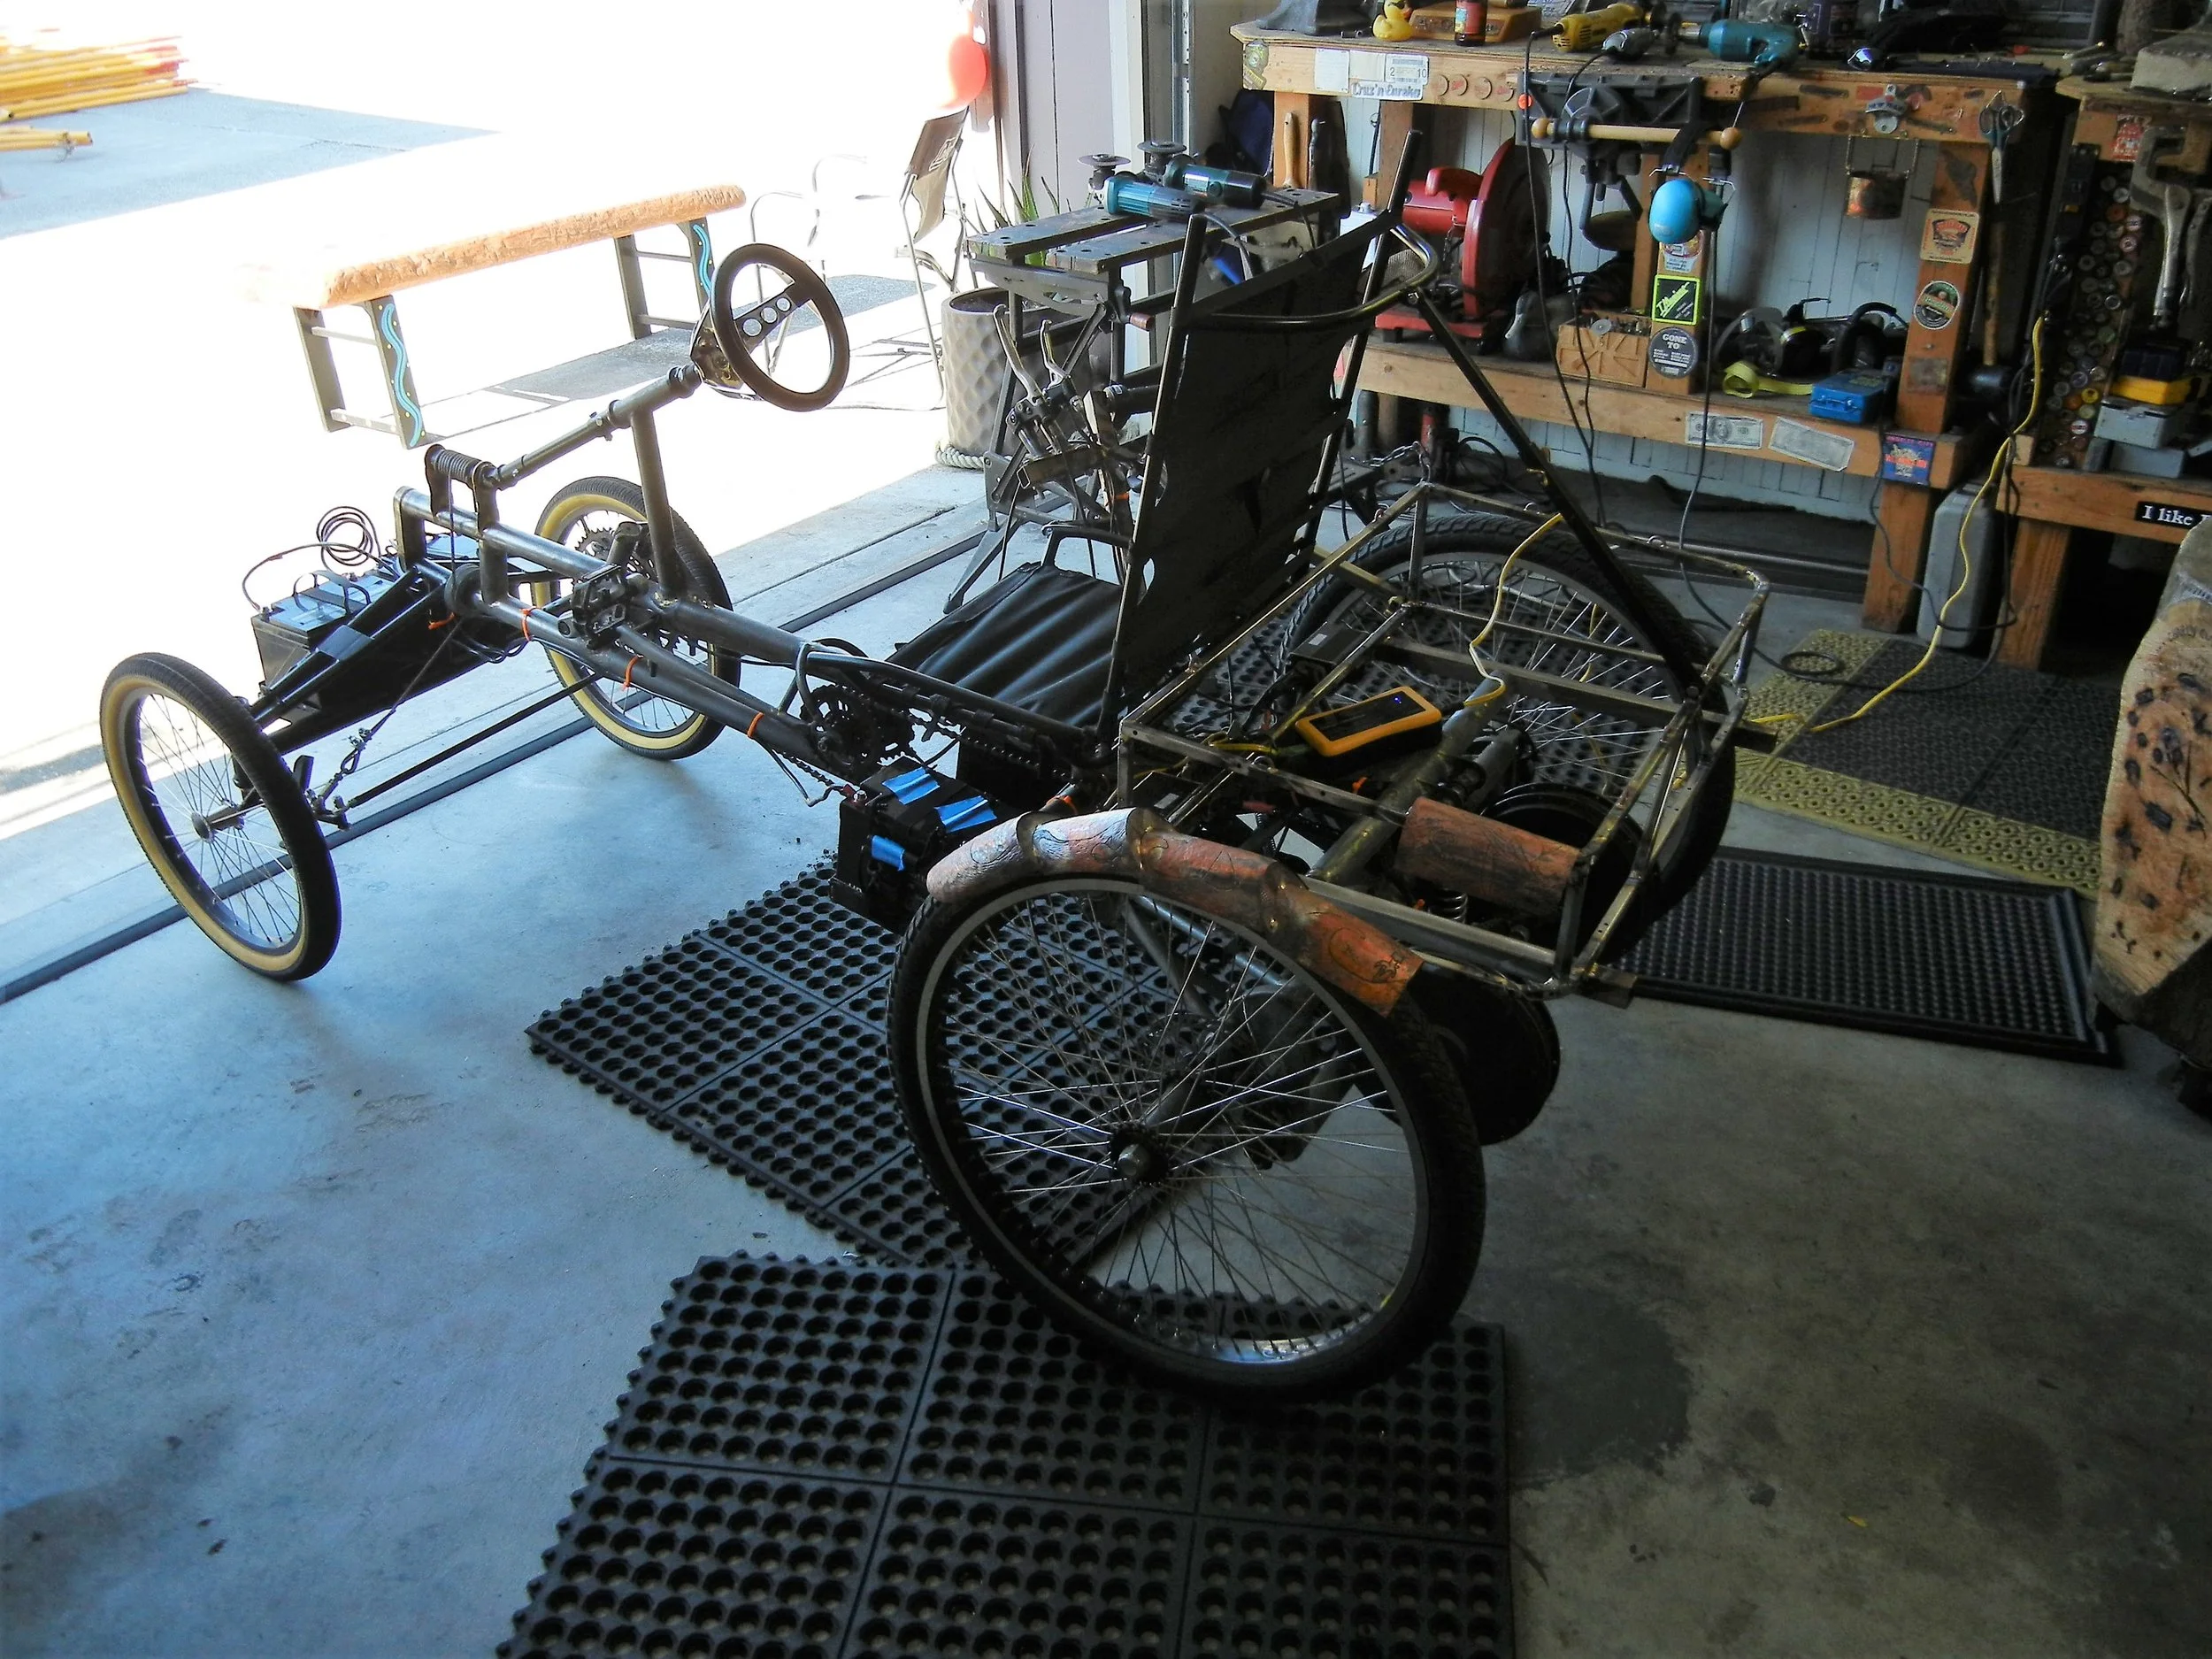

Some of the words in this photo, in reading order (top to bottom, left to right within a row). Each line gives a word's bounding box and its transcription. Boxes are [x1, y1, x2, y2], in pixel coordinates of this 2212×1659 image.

[1662, 333, 1687, 344] GONE
[2142, 505, 2153, 519] I
[2157, 507, 2193, 526] like
